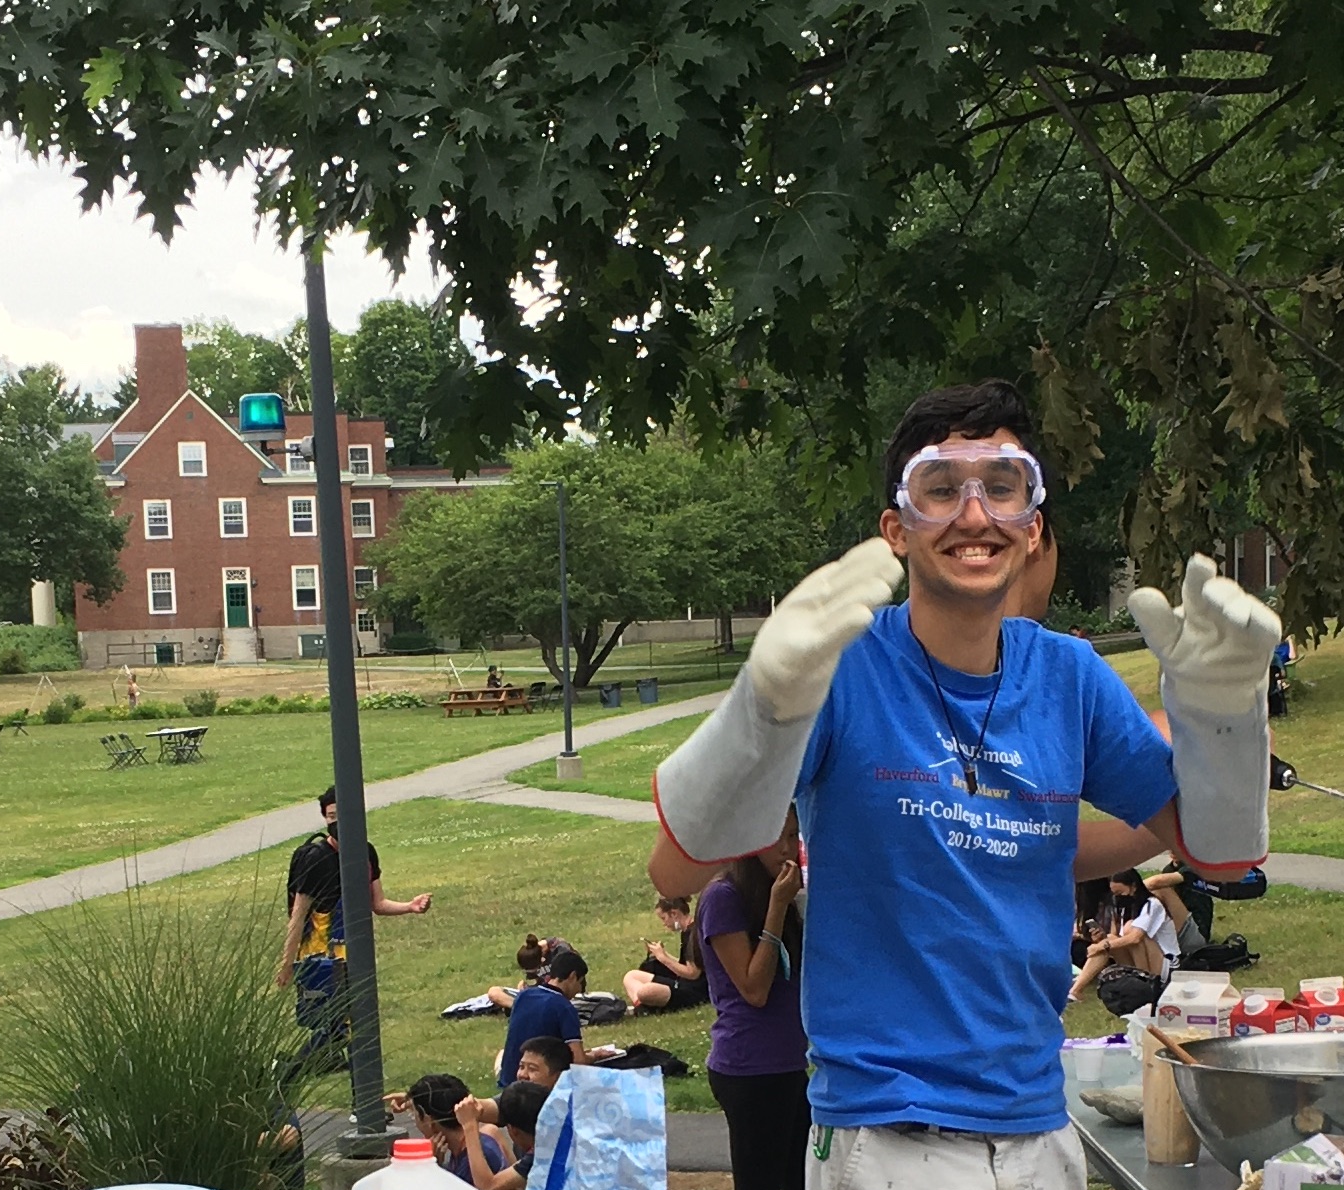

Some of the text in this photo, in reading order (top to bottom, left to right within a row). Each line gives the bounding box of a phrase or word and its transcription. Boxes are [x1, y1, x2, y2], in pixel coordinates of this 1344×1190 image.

[873, 767, 940, 783] Haverford
[975, 783, 1009, 799] Mawr
[897, 797, 1061, 837] Tri-College Linguistics
[947, 831, 1018, 858] 2019-2020
